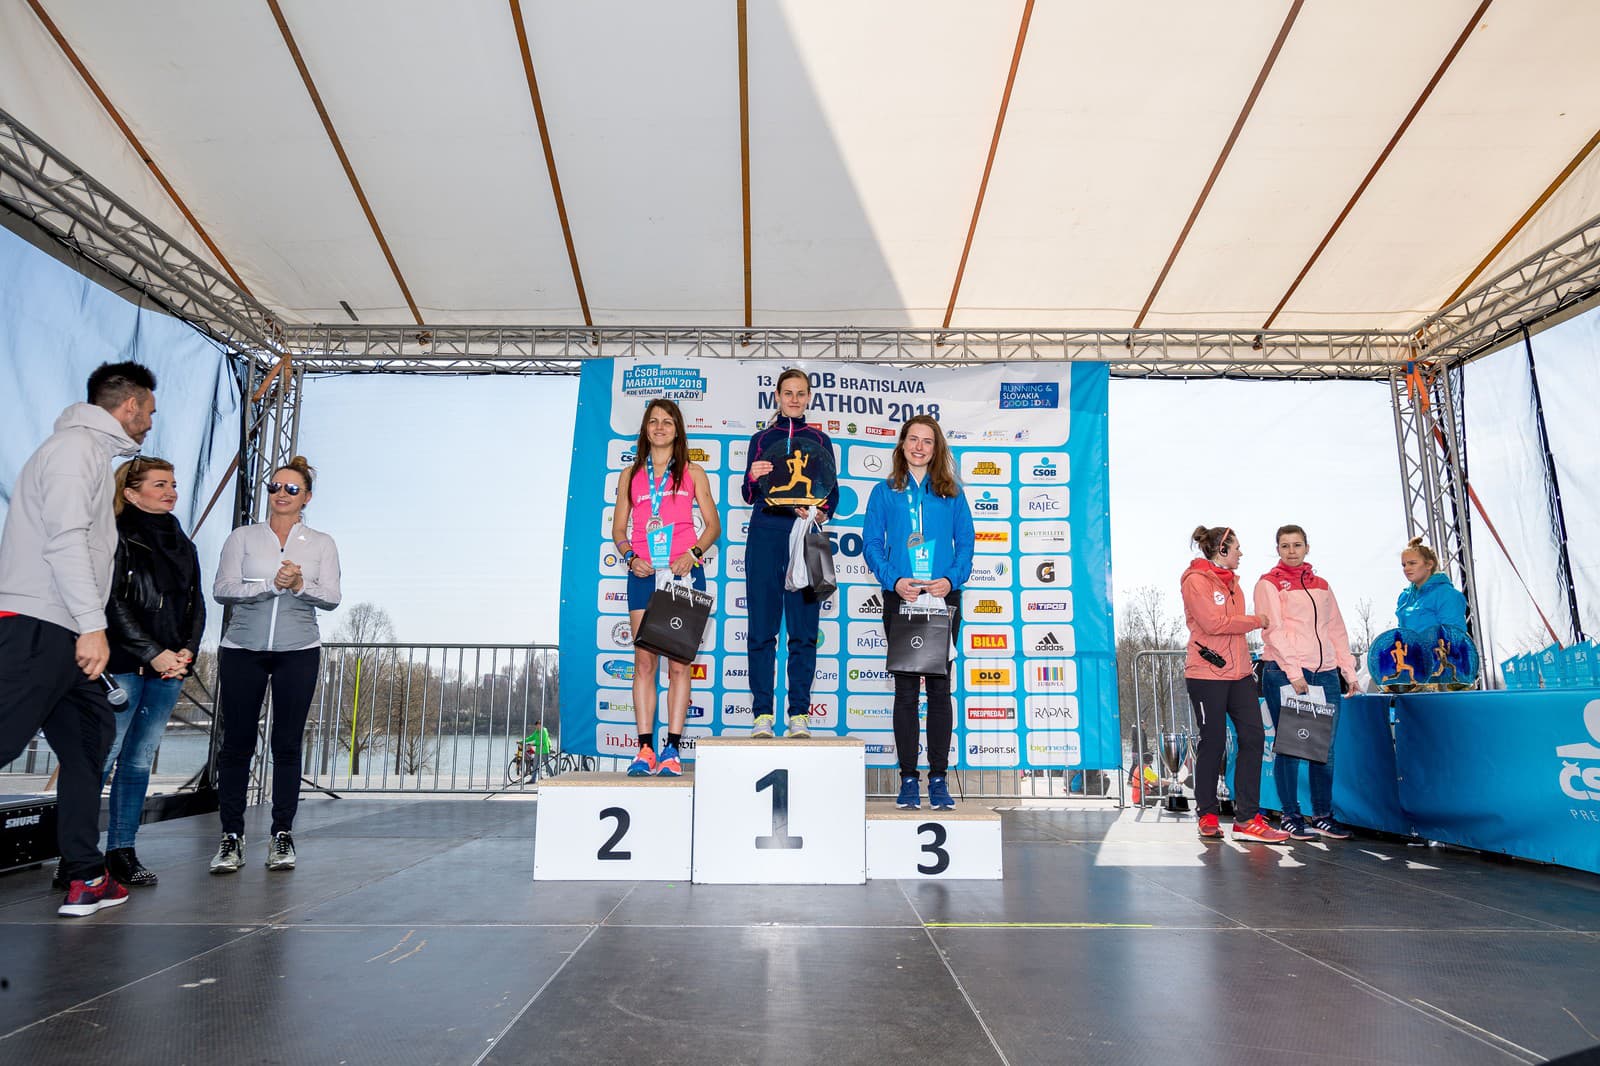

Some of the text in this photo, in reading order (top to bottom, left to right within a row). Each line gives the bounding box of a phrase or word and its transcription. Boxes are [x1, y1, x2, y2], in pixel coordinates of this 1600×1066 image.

[634, 367, 658, 377] ČSOB
[626, 378, 702, 388] MARATHON 2018
[756, 376, 776, 386] 13.
[840, 378, 926, 394] BRATISLAVA
[758, 392, 883, 415] MATHON
[1028, 501, 1060, 512] RAJEC
[857, 638, 888, 649] RAJEC
[973, 636, 1006, 648] BILLA
[980, 672, 1000, 680] OLO
[1034, 707, 1072, 719] RADAR
[979, 744, 1016, 754] ŠPORT.SK
[1559, 760, 1600, 802] ČS
[754, 769, 804, 850] 1
[5, 814, 42, 829] SHURE
[597, 806, 632, 860] 2
[916, 822, 950, 875] 3
